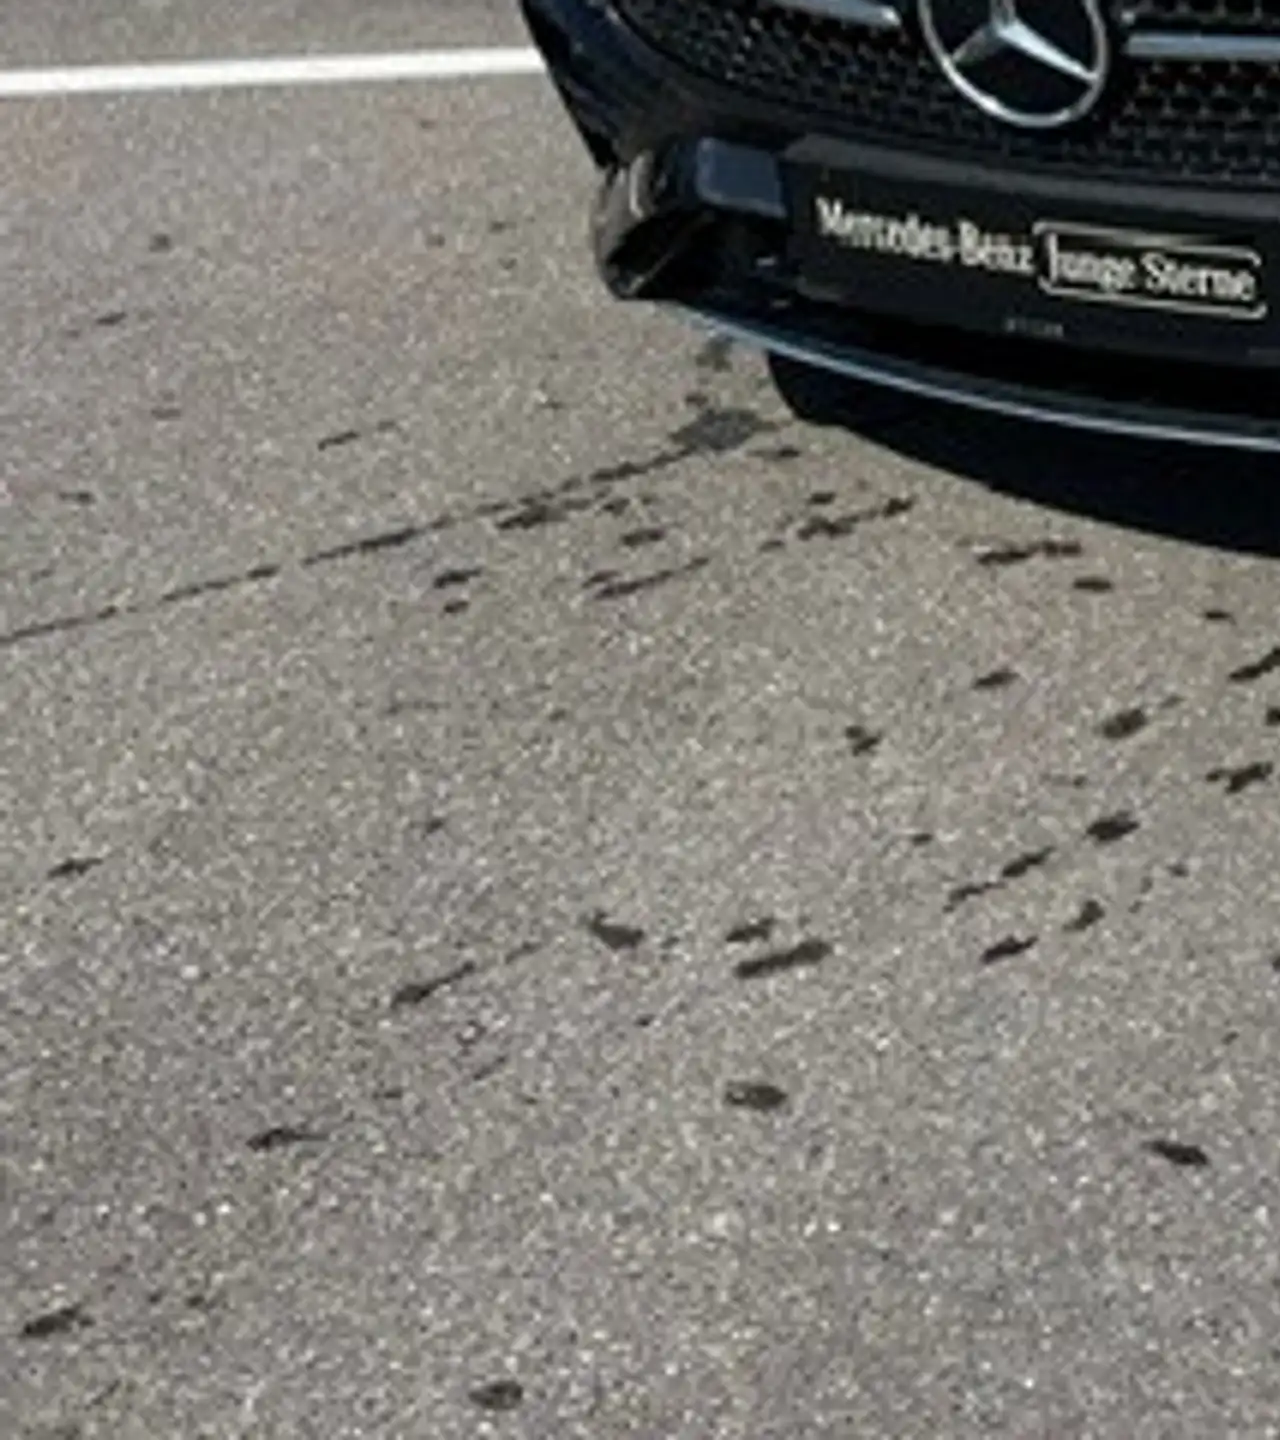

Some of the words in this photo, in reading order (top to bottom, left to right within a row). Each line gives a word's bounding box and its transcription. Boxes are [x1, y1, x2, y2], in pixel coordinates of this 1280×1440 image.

[815, 196, 1037, 276] Mercedes-Benz
[1046, 233, 1137, 292] Junge
[1139, 251, 1256, 301] Sterne
